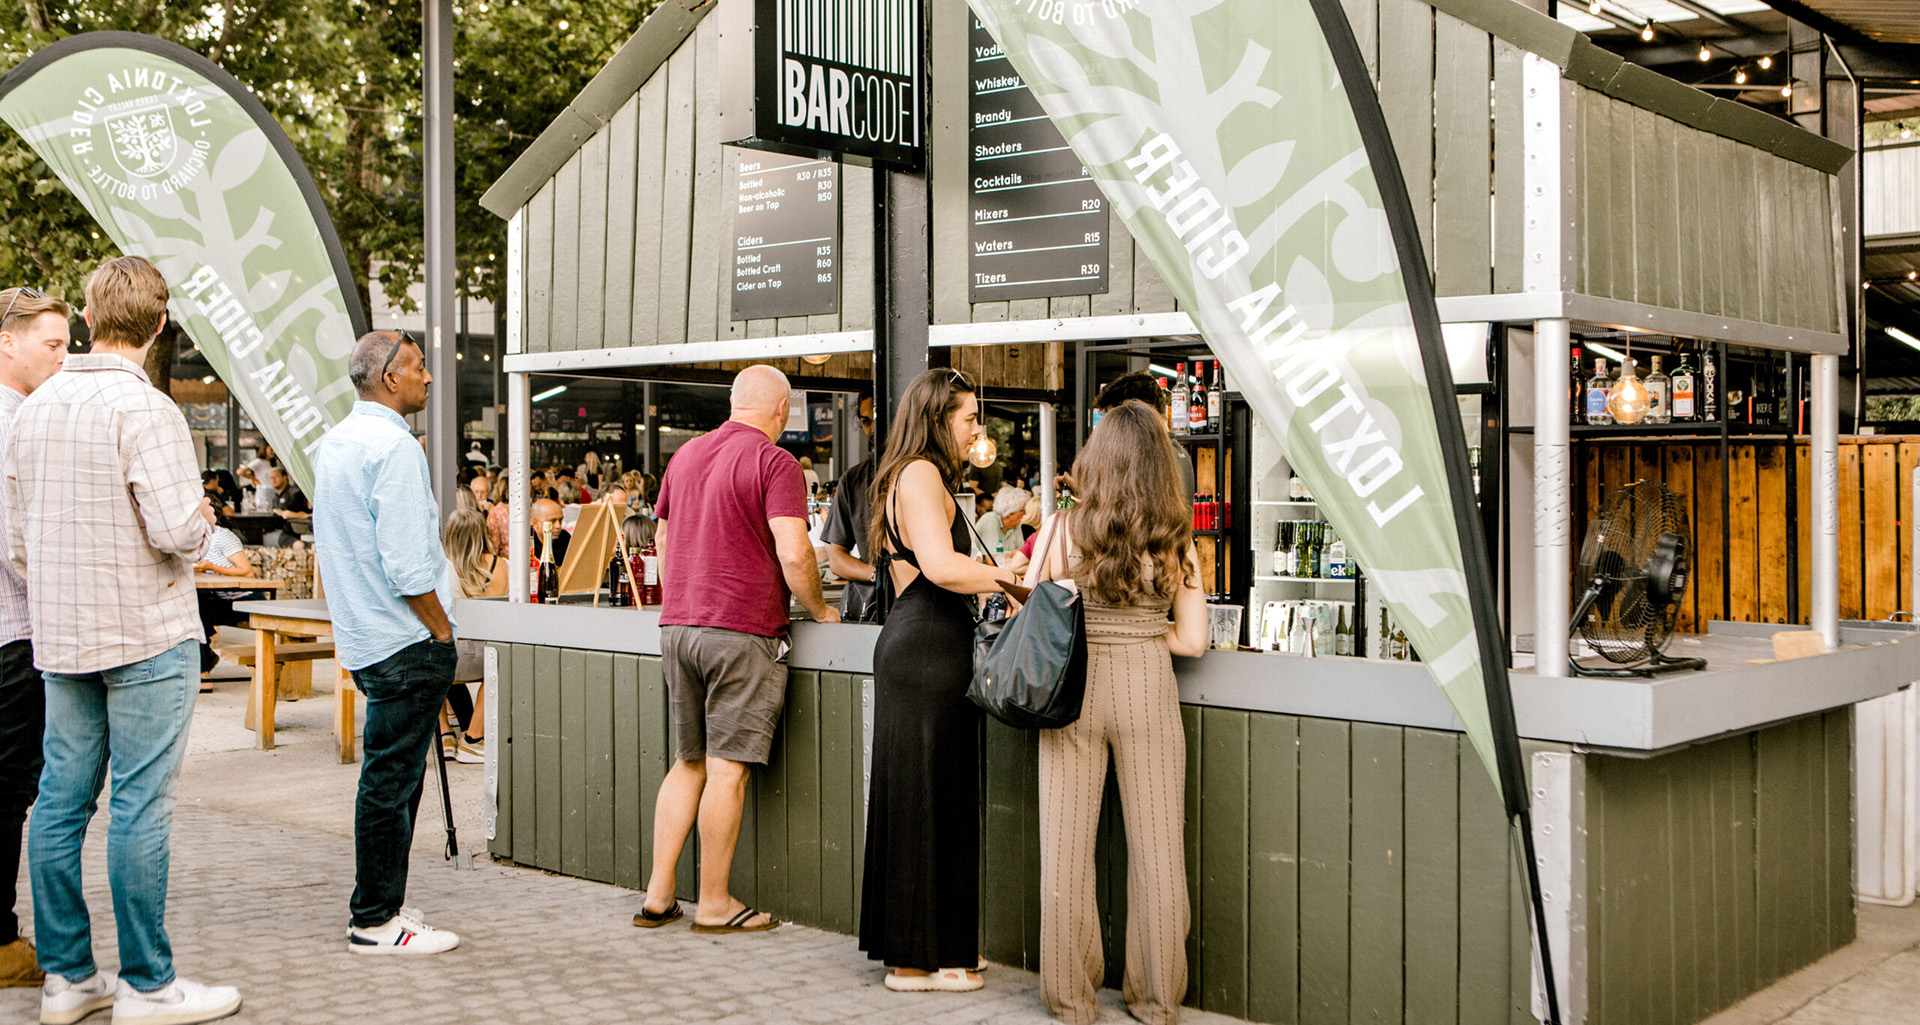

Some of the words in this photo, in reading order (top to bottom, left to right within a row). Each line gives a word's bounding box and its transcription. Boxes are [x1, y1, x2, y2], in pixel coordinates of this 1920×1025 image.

[975, 44, 1005, 58] Vodk
[975, 76, 1020, 91] Whiskey
[785, 58, 911, 147] BARCODE
[975, 109, 1012, 124] Brandy
[975, 142, 1022, 157] Shooters
[740, 162, 761, 173] Beers
[739, 178, 763, 190] Bottled
[797, 171, 811, 181] R30
[817, 167, 832, 178] R35
[974, 173, 1022, 189] Cocktails
[738, 188, 785, 202] Non-alcoholic
[817, 180, 833, 190] R30
[738, 205, 754, 214] Beer
[755, 203, 764, 211] on
[766, 200, 780, 211] Tap
[817, 192, 833, 202] R50
[975, 208, 1009, 221] Mixers
[1082, 199, 1100, 210] R20
[737, 236, 763, 247] Ciders
[975, 240, 1013, 252] Waters
[1084, 232, 1100, 243] R15
[736, 253, 761, 265] Bottled
[816, 245, 831, 256] R35
[736, 266, 761, 277] Bottled
[762, 264, 781, 274] Craft
[816, 259, 832, 268] R60
[975, 273, 1007, 284] Tizers
[1081, 264, 1100, 275] R30
[736, 281, 756, 291] Cider
[757, 281, 767, 289] on
[768, 278, 782, 289] Tap
[817, 273, 832, 283] R65
